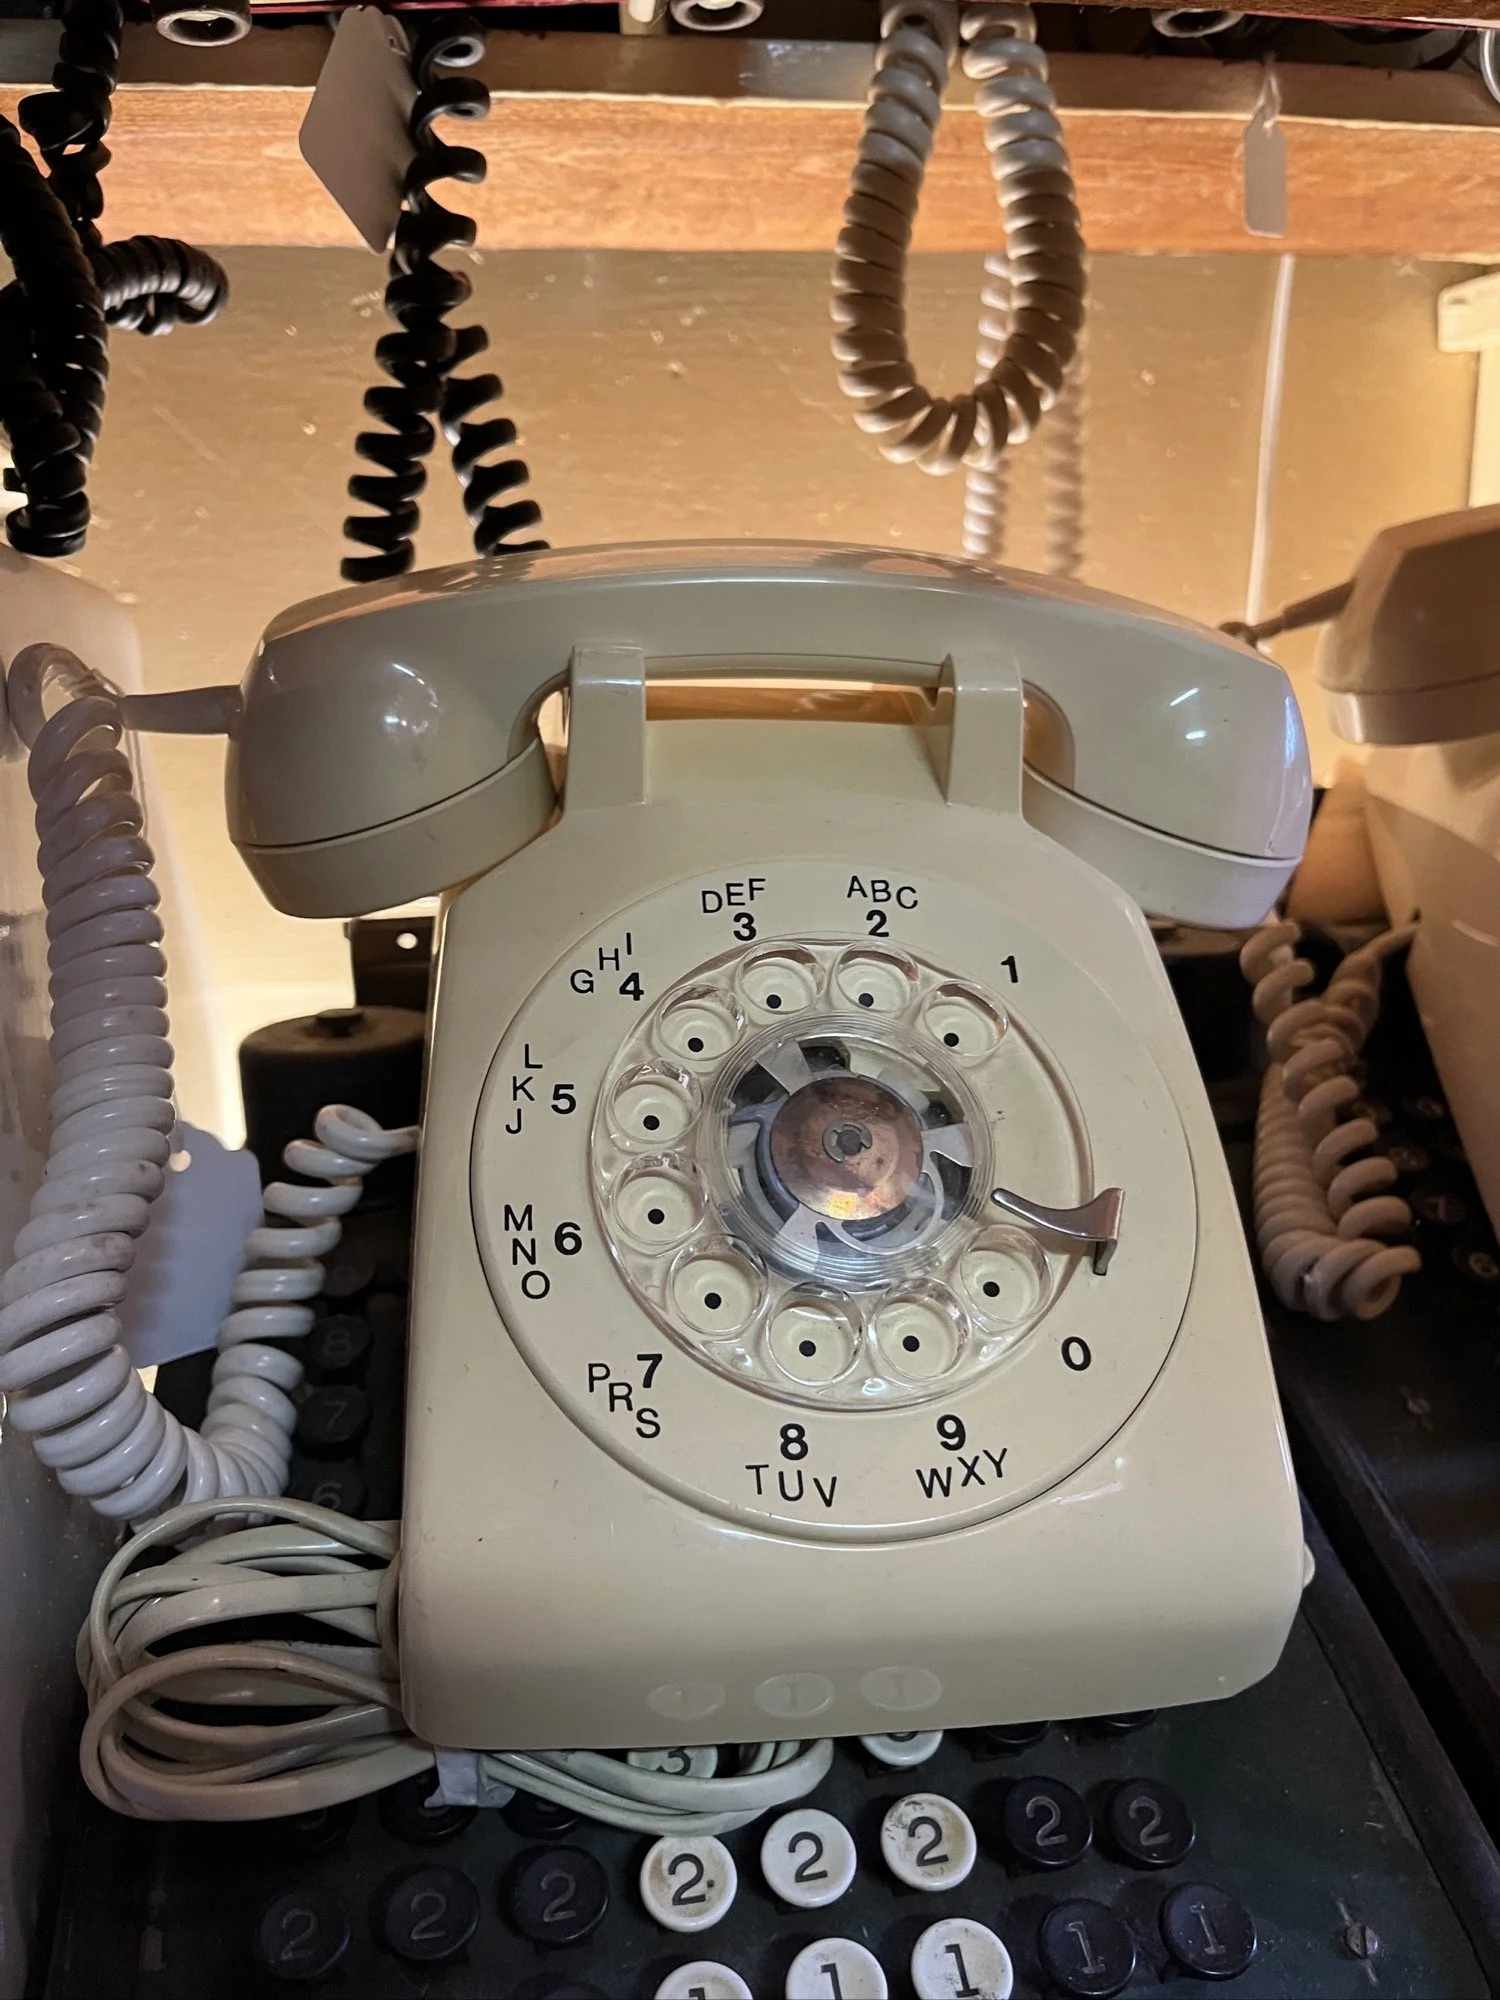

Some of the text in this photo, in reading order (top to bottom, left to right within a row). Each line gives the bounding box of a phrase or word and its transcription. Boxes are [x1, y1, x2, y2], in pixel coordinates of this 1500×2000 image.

[702, 879, 766, 914] DEF
[847, 876, 919, 910] ABC
[733, 911, 757, 942] 3
[866, 909, 890, 938] 2
[618, 972, 645, 1002] 4
[1000, 955, 1019, 985] 1
[550, 1083, 577, 1115] 5
[554, 1221, 583, 1256] 6
[636, 1353, 663, 1389] 7
[1061, 1336, 1092, 1372] 0
[779, 1423, 809, 1461] 8
[936, 1414, 967, 1452] 9
[745, 1464, 838, 1508] TUV
[915, 1447, 1008, 1499] WXY
[907, 1815, 950, 1867] 2
[1025, 1795, 1069, 1847] 2
[1128, 1796, 1173, 1847] 2
[667, 1852, 706, 1906] 2
[787, 1831, 829, 1884] 2
[410, 1889, 447, 1940] 2
[540, 1870, 577, 1923] 2
[281, 1908, 318, 1960] 2
[1065, 1920, 1107, 1975] 1
[1192, 1902, 1227, 1956] 1
[944, 1943, 982, 2000] 1
